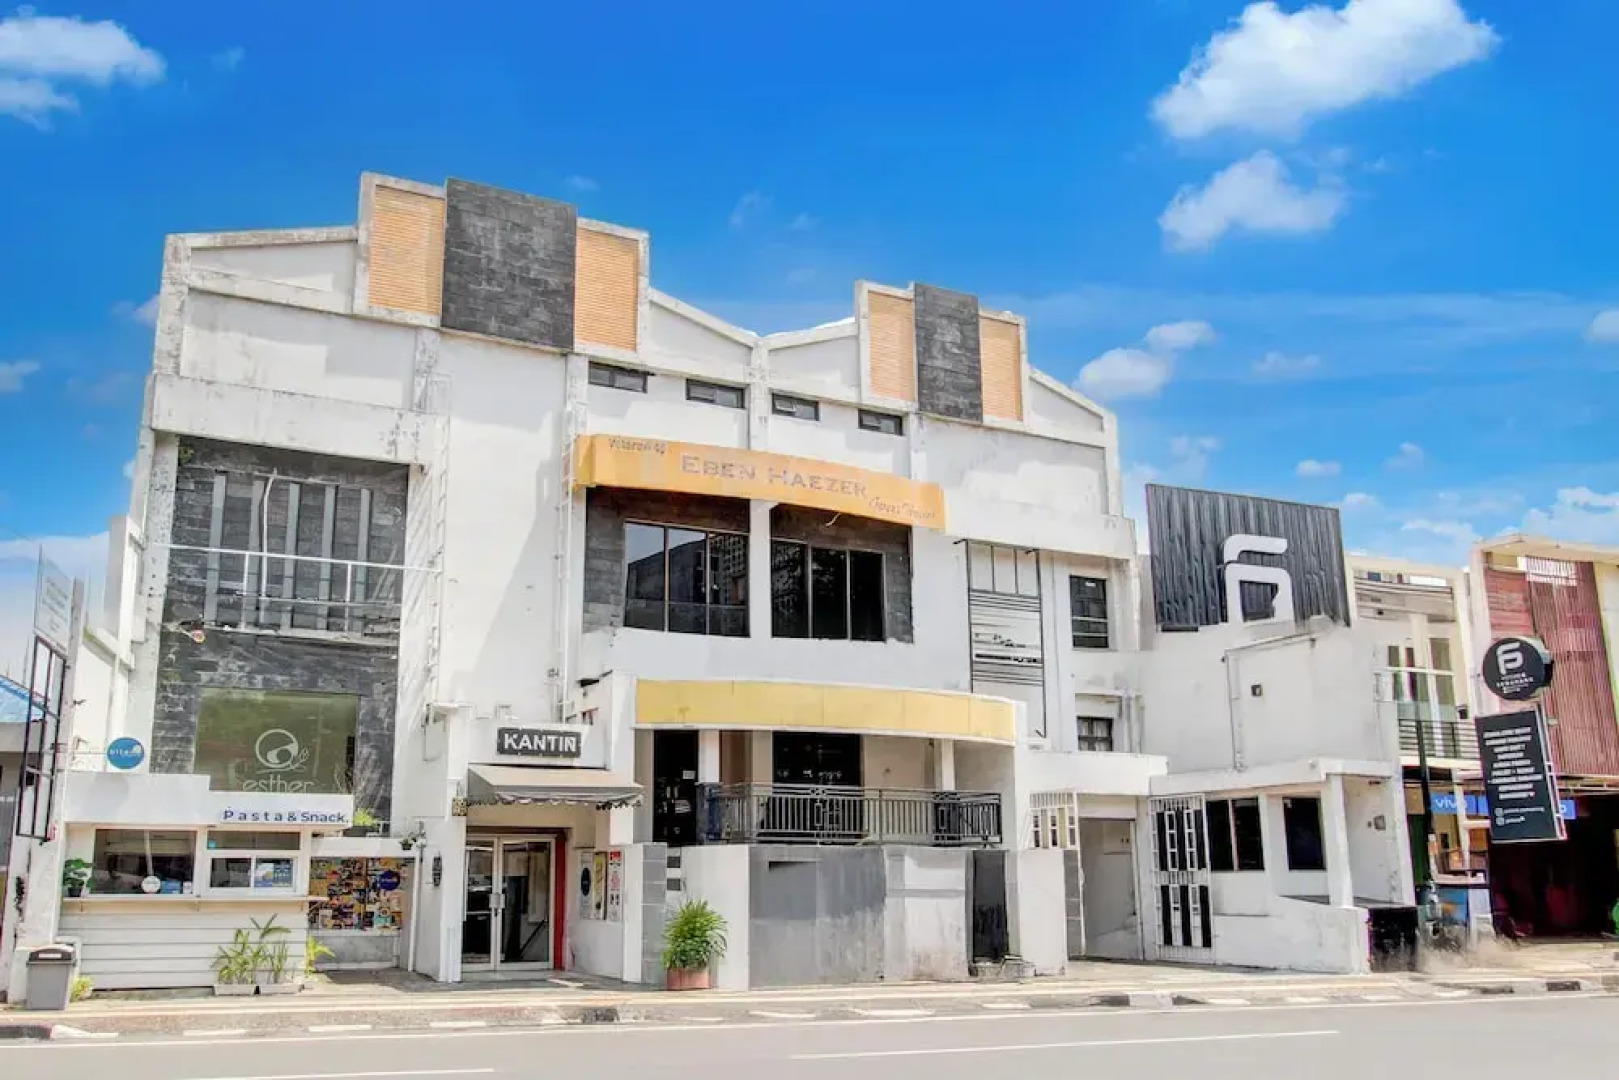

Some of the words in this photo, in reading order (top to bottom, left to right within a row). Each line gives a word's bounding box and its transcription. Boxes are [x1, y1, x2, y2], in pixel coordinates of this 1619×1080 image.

[682, 453, 756, 481] EBEN
[767, 466, 868, 499] HAEZER
[504, 732, 577, 752] KANTIN
[242, 773, 315, 793] esther
[223, 810, 283, 822] Pasta
[287, 811, 297, 822] &
